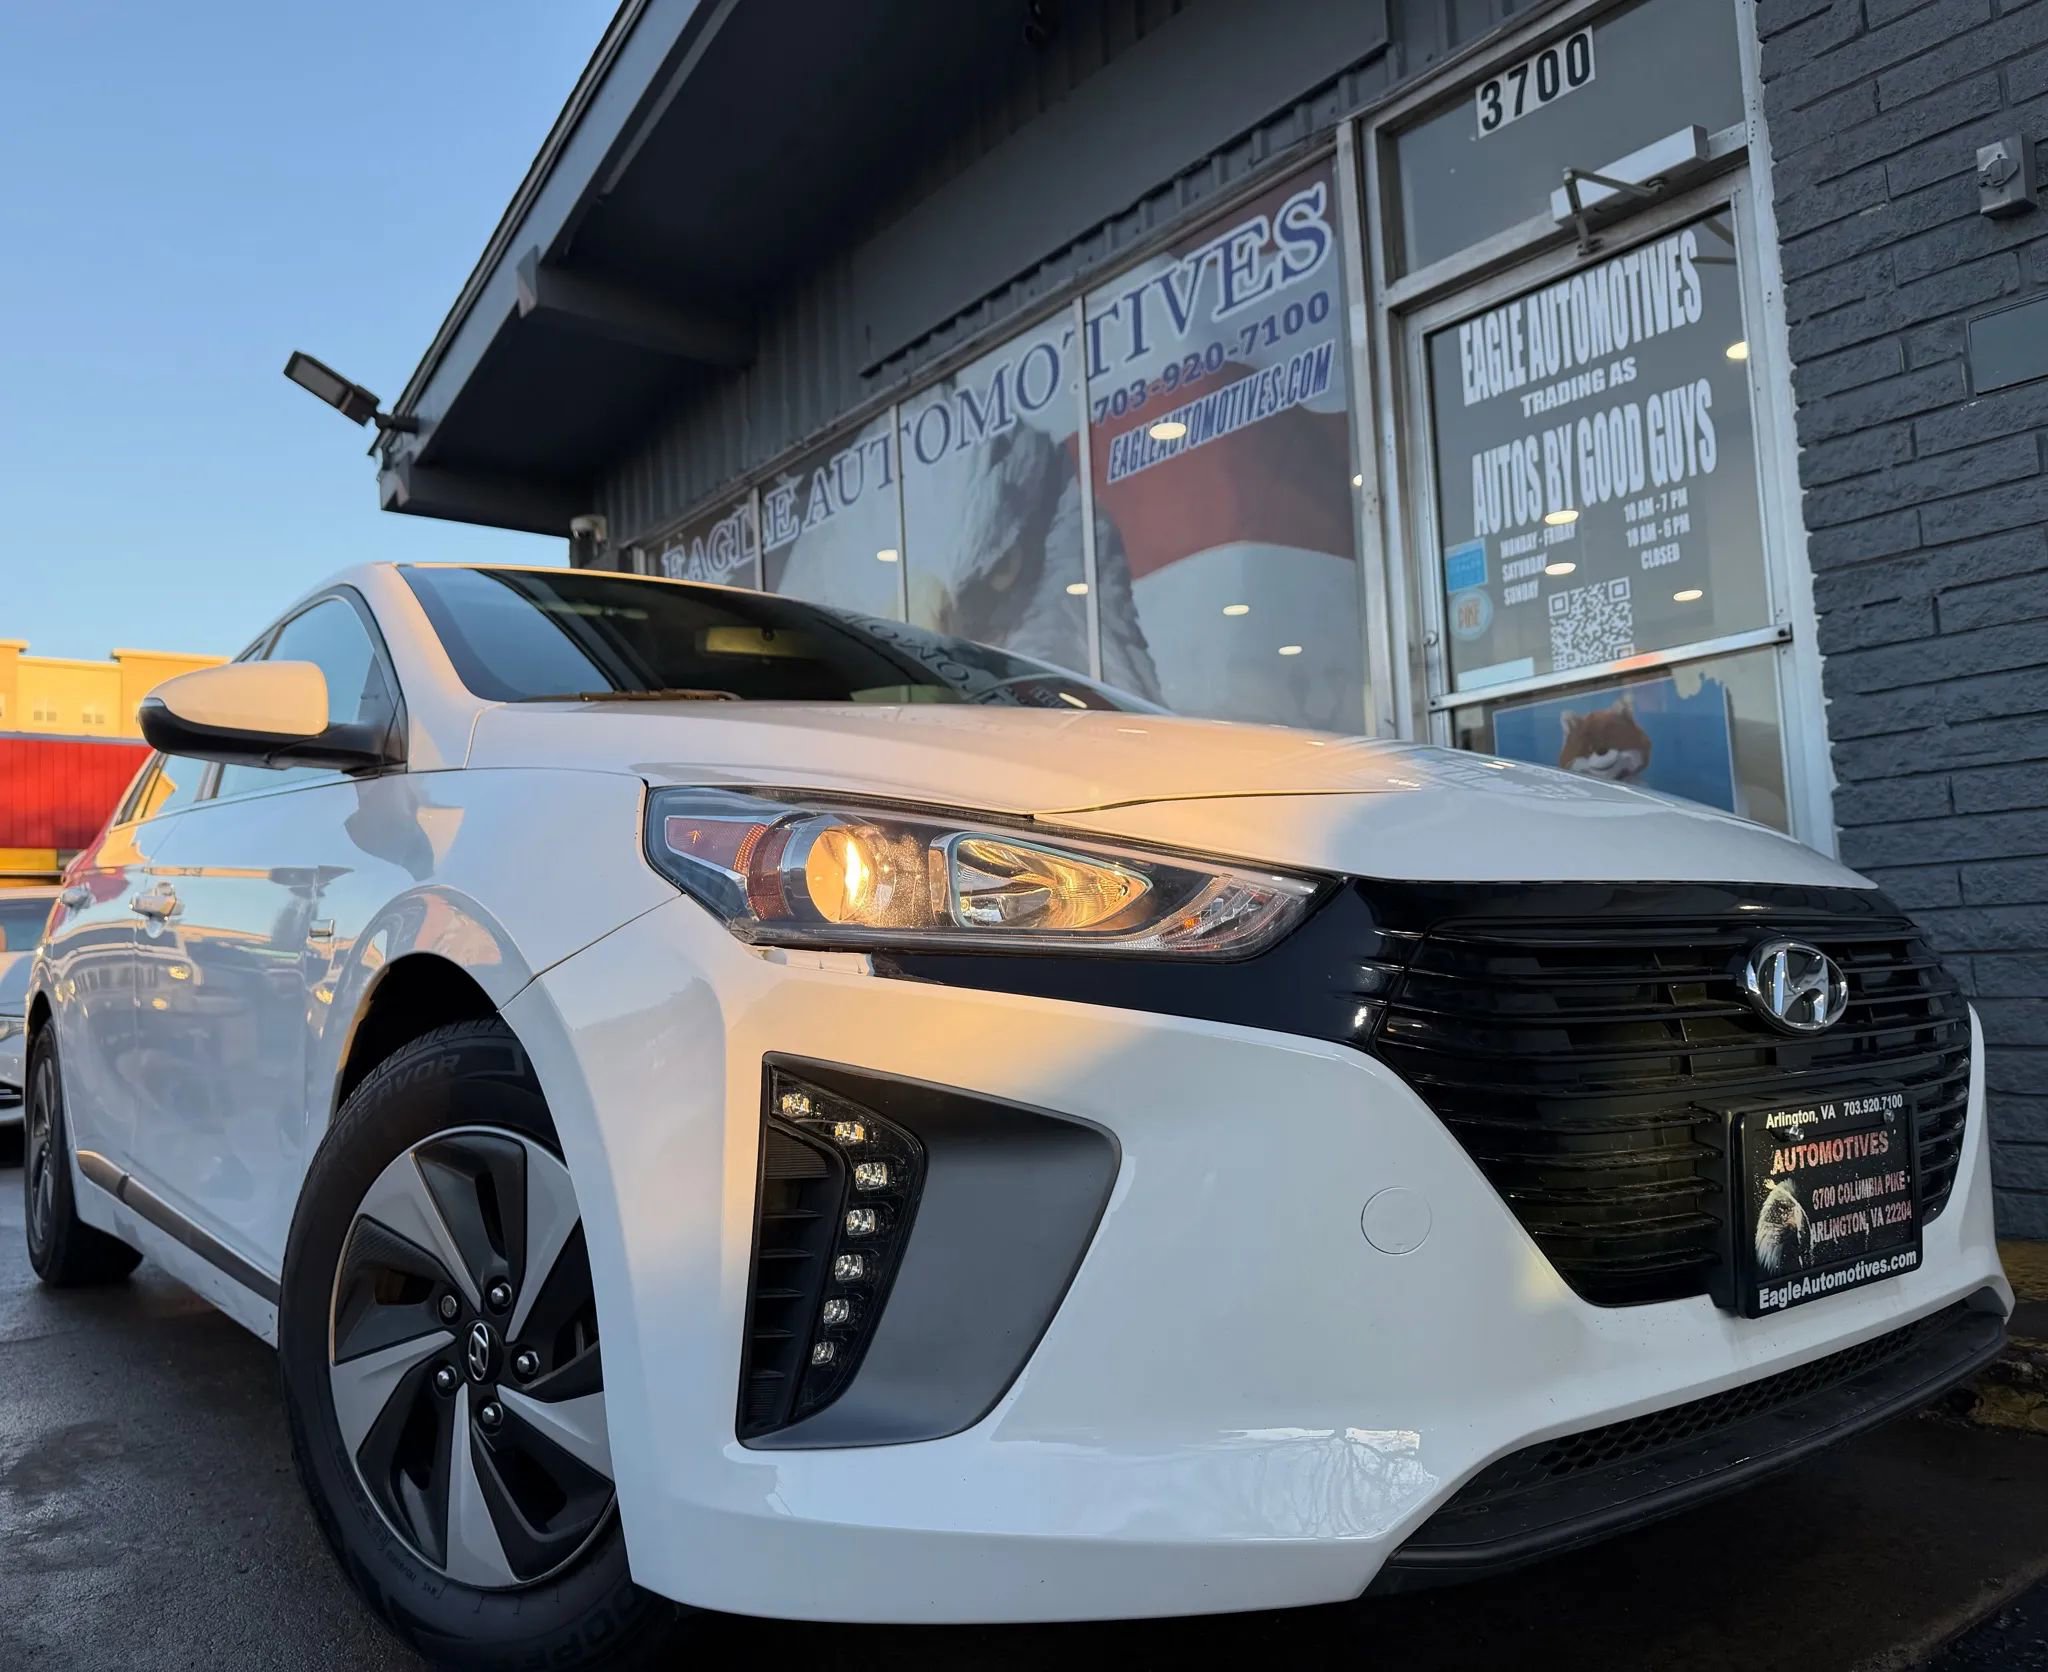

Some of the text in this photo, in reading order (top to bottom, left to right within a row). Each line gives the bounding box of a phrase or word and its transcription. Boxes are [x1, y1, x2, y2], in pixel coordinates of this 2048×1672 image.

[1481, 33, 1591, 131] 3700
[1459, 229, 1702, 407] EAGLE AUTOMOTIVES
[1094, 291, 1330, 425] 703-920-7100
[661, 181, 1333, 582] EAGLE AUTOMOTIVES
[1520, 357, 1637, 418] TRADING AS
[1107, 339, 1335, 485] EAGLEAUTOMOTIVES.COM
[1472, 378, 1717, 538] AUTOS BY GOOD GUYS
[1624, 502, 1637, 523] 10
[1637, 496, 1655, 520] AM
[1660, 492, 1668, 513] 7
[1670, 487, 1689, 510] PM
[1626, 527, 1639, 548] 10
[1640, 521, 1657, 545] AM
[1672, 512, 1690, 537] PM
[1502, 552, 1548, 583] SATURDAY
[1641, 542, 1681, 570] CLOSED
[1504, 579, 1539, 607] SUNDAY
[1766, 1094, 1903, 1130] Arlington, VA 703.920.7100
[1771, 1130, 1889, 1175] AUTOMOTIVES
[1812, 1170, 1906, 1210] 3700 COLUMBIA PIKE
[1870, 1206, 1884, 1228] VA
[1885, 1200, 1912, 1225] 22204
[1759, 1250, 1917, 1309] EagleAutomotives.com
